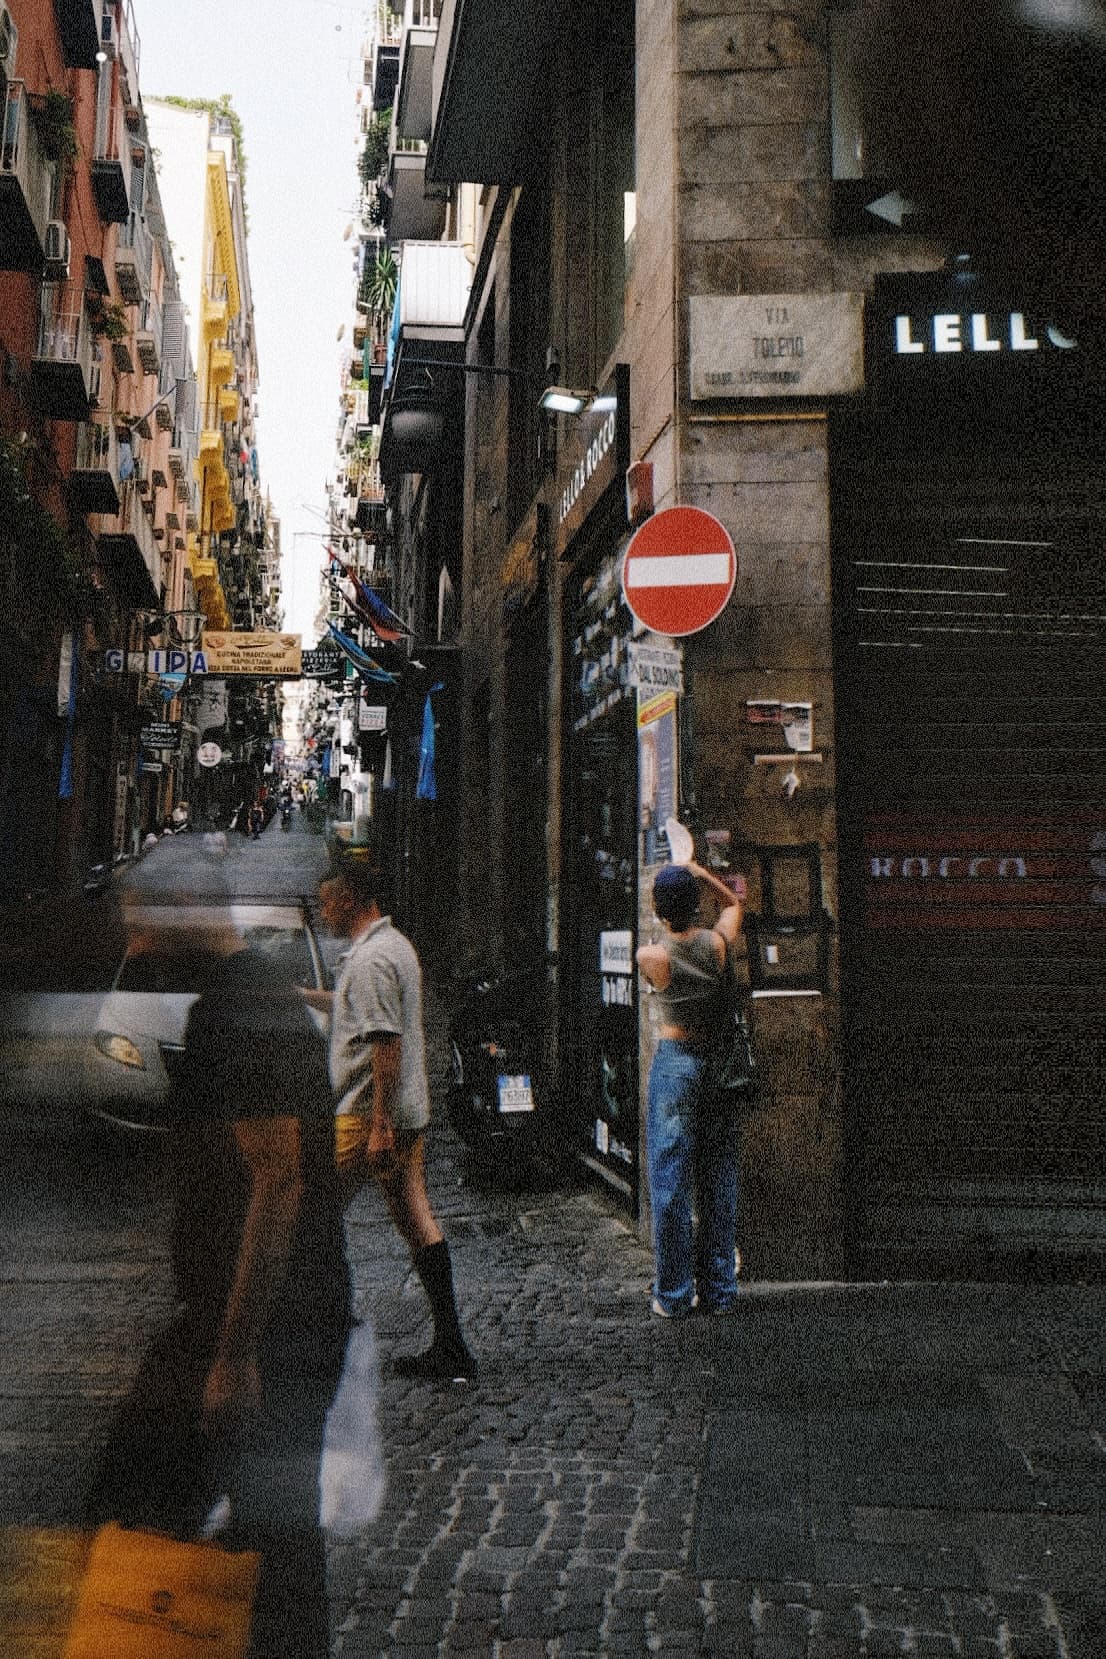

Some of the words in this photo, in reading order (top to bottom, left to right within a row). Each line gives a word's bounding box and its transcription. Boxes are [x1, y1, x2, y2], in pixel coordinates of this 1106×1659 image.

[765, 307, 790, 325] VIA
[753, 336, 804, 359] TOLEDO
[587, 411, 615, 480] ROCCO
